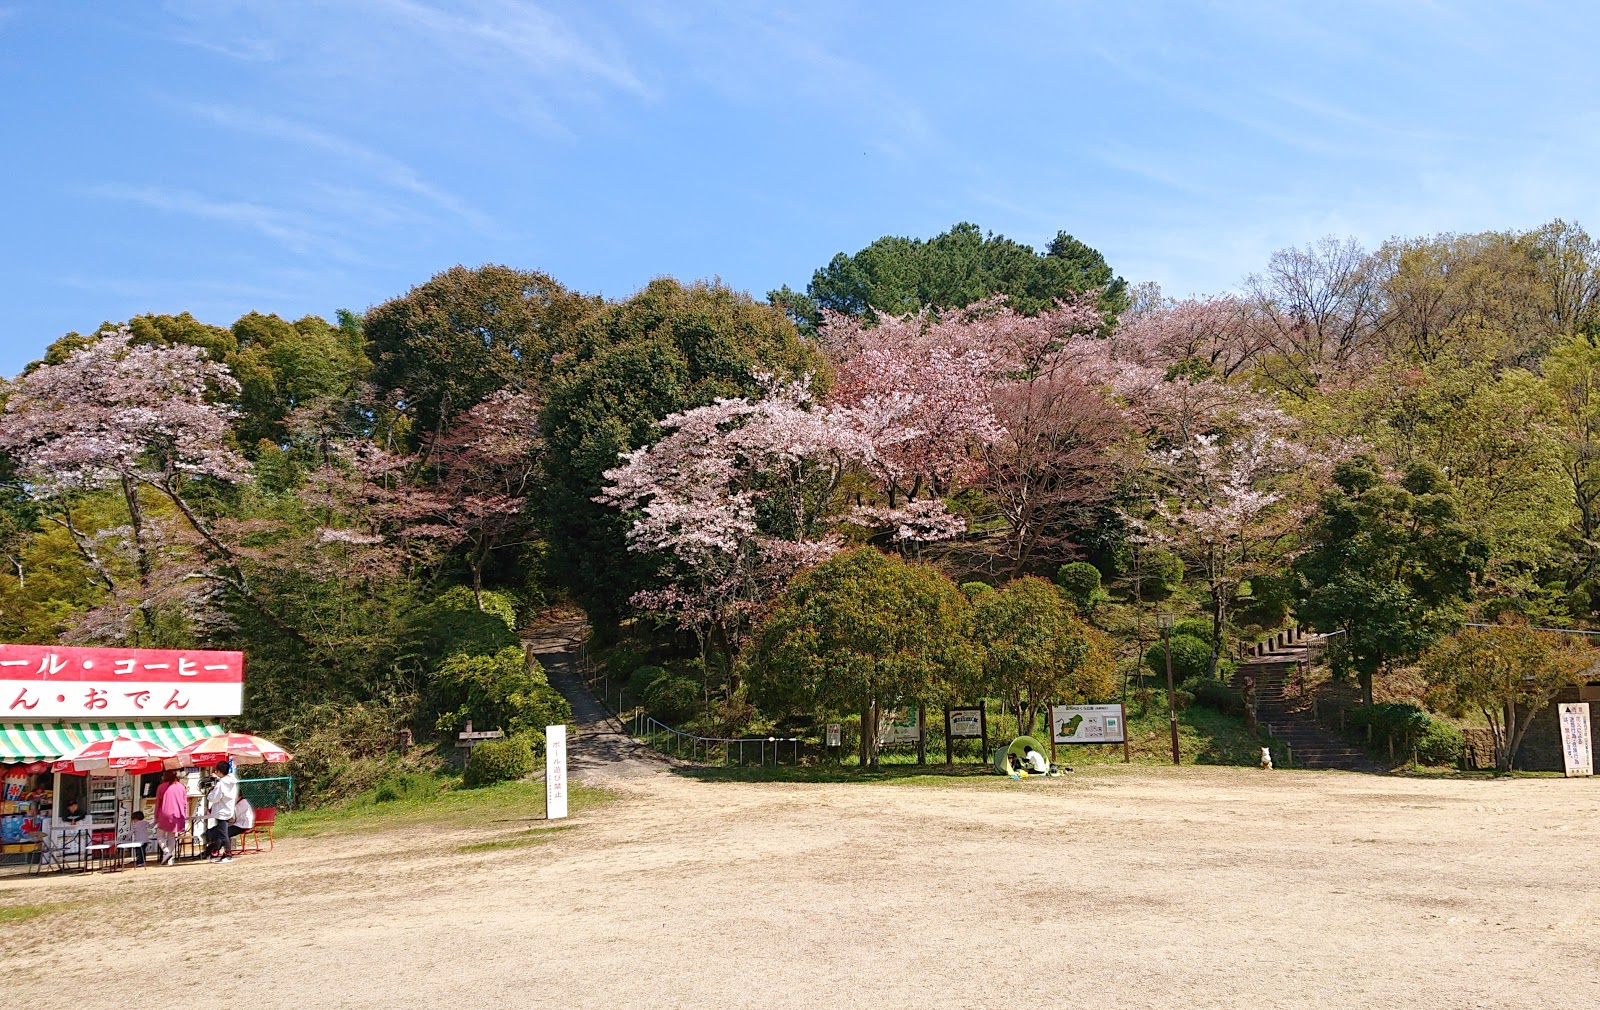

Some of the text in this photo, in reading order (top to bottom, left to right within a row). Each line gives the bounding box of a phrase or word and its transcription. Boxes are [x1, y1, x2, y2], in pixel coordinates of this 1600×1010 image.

[552, 741, 562, 798] ボール遊び禁止
